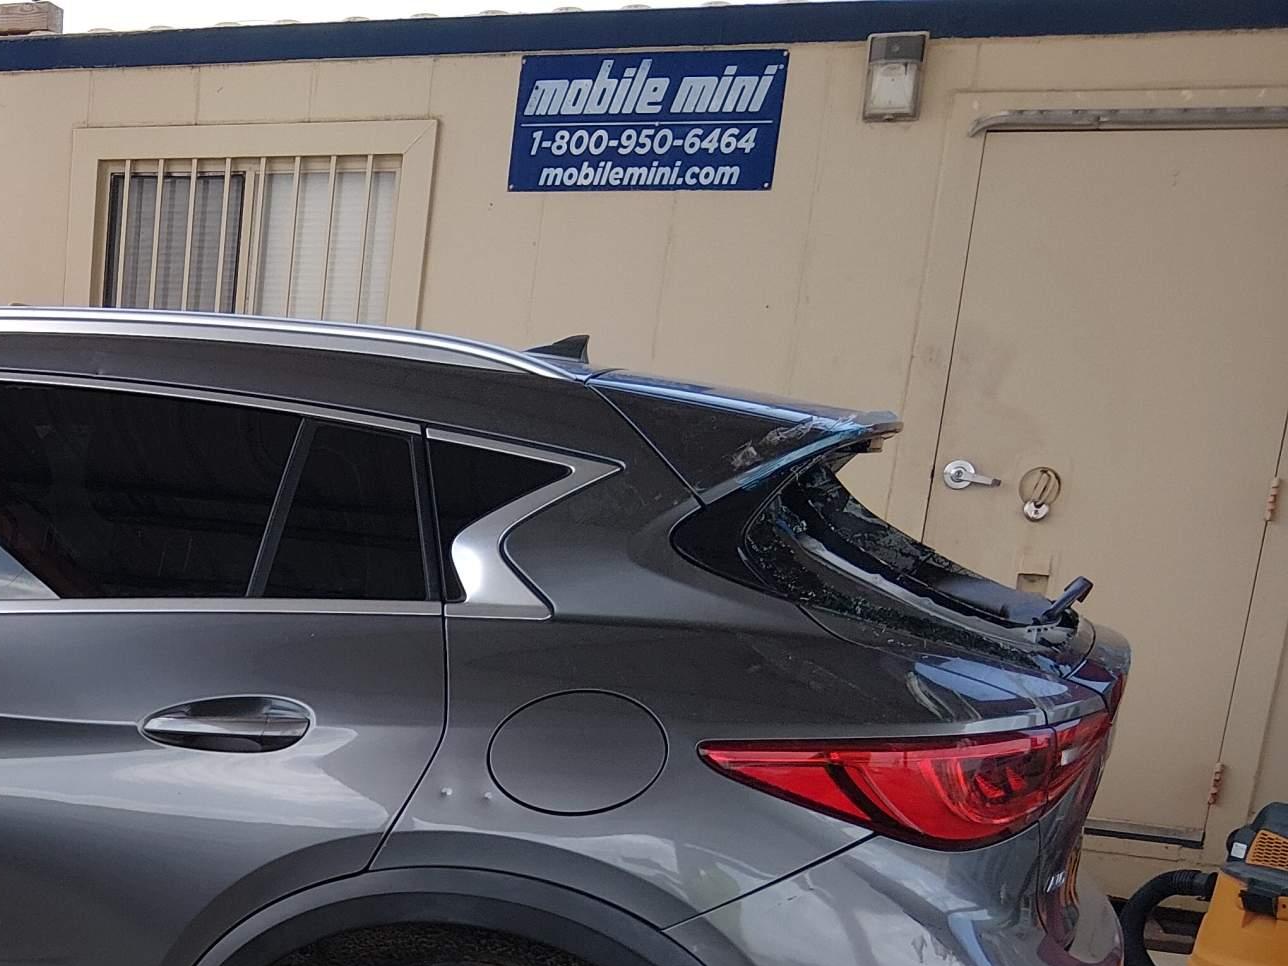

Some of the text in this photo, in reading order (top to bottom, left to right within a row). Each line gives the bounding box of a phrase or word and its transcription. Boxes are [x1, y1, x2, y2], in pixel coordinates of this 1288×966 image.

[523, 59, 778, 115] mobile mini
[530, 127, 758, 156] 1-800-950-6464
[538, 160, 740, 186] mobilemini.com
